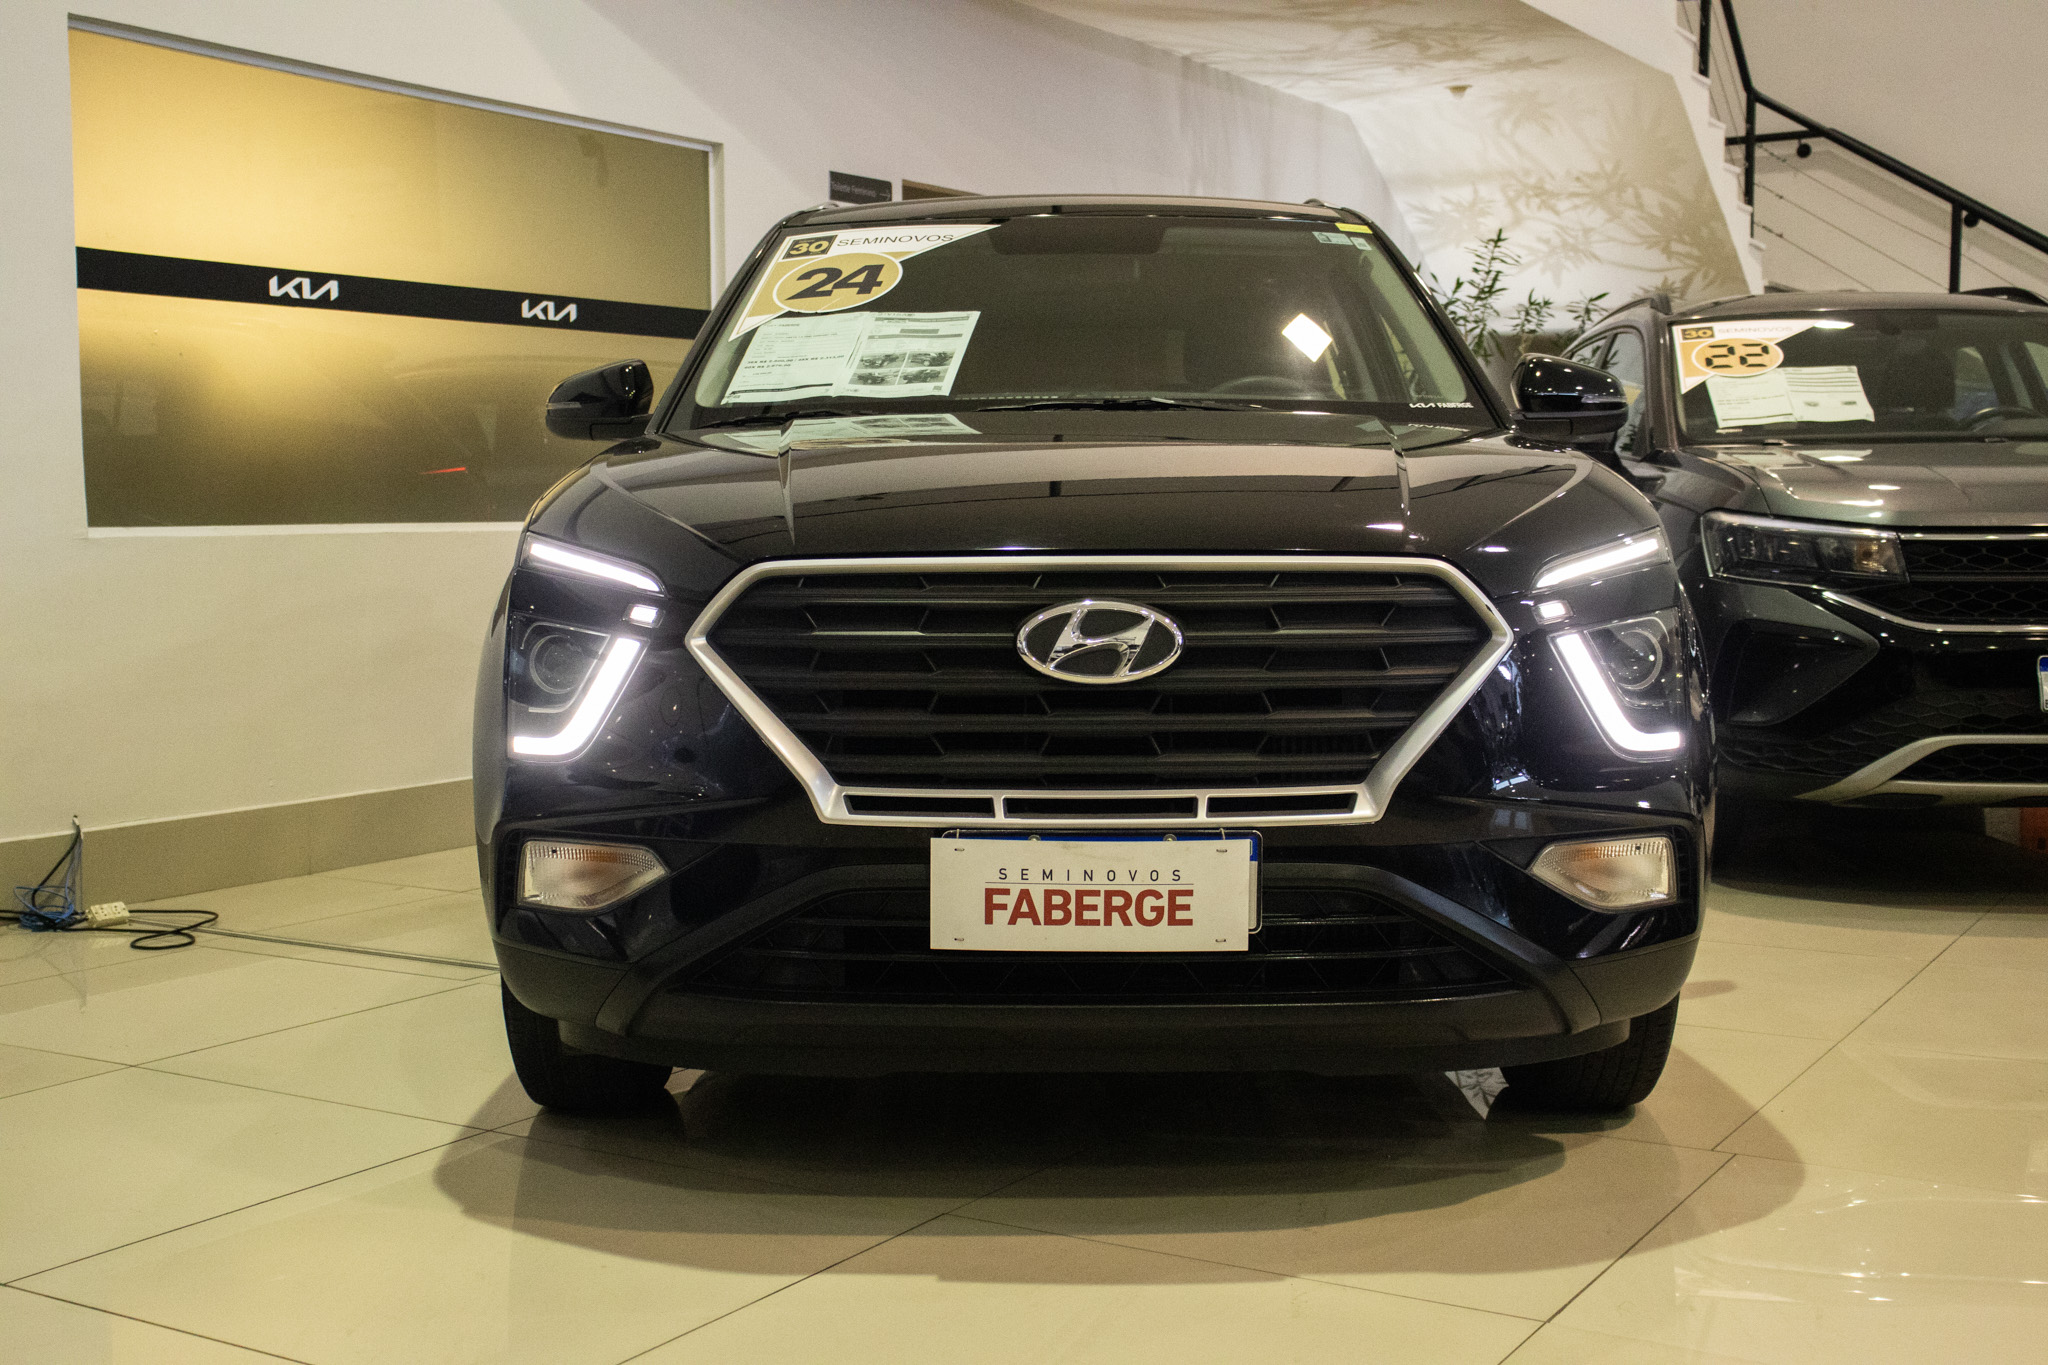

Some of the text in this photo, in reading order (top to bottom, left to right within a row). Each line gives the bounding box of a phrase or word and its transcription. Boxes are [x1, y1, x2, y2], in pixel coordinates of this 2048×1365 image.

[790, 234, 954, 255] 30 SEMINOVOS
[784, 264, 885, 301] 24
[1684, 326, 1793, 338] 30 SEMINOVOS
[1705, 343, 1769, 369] 22
[998, 868, 1181, 882] SEMINOVOS
[984, 888, 1194, 927] FABERGE
